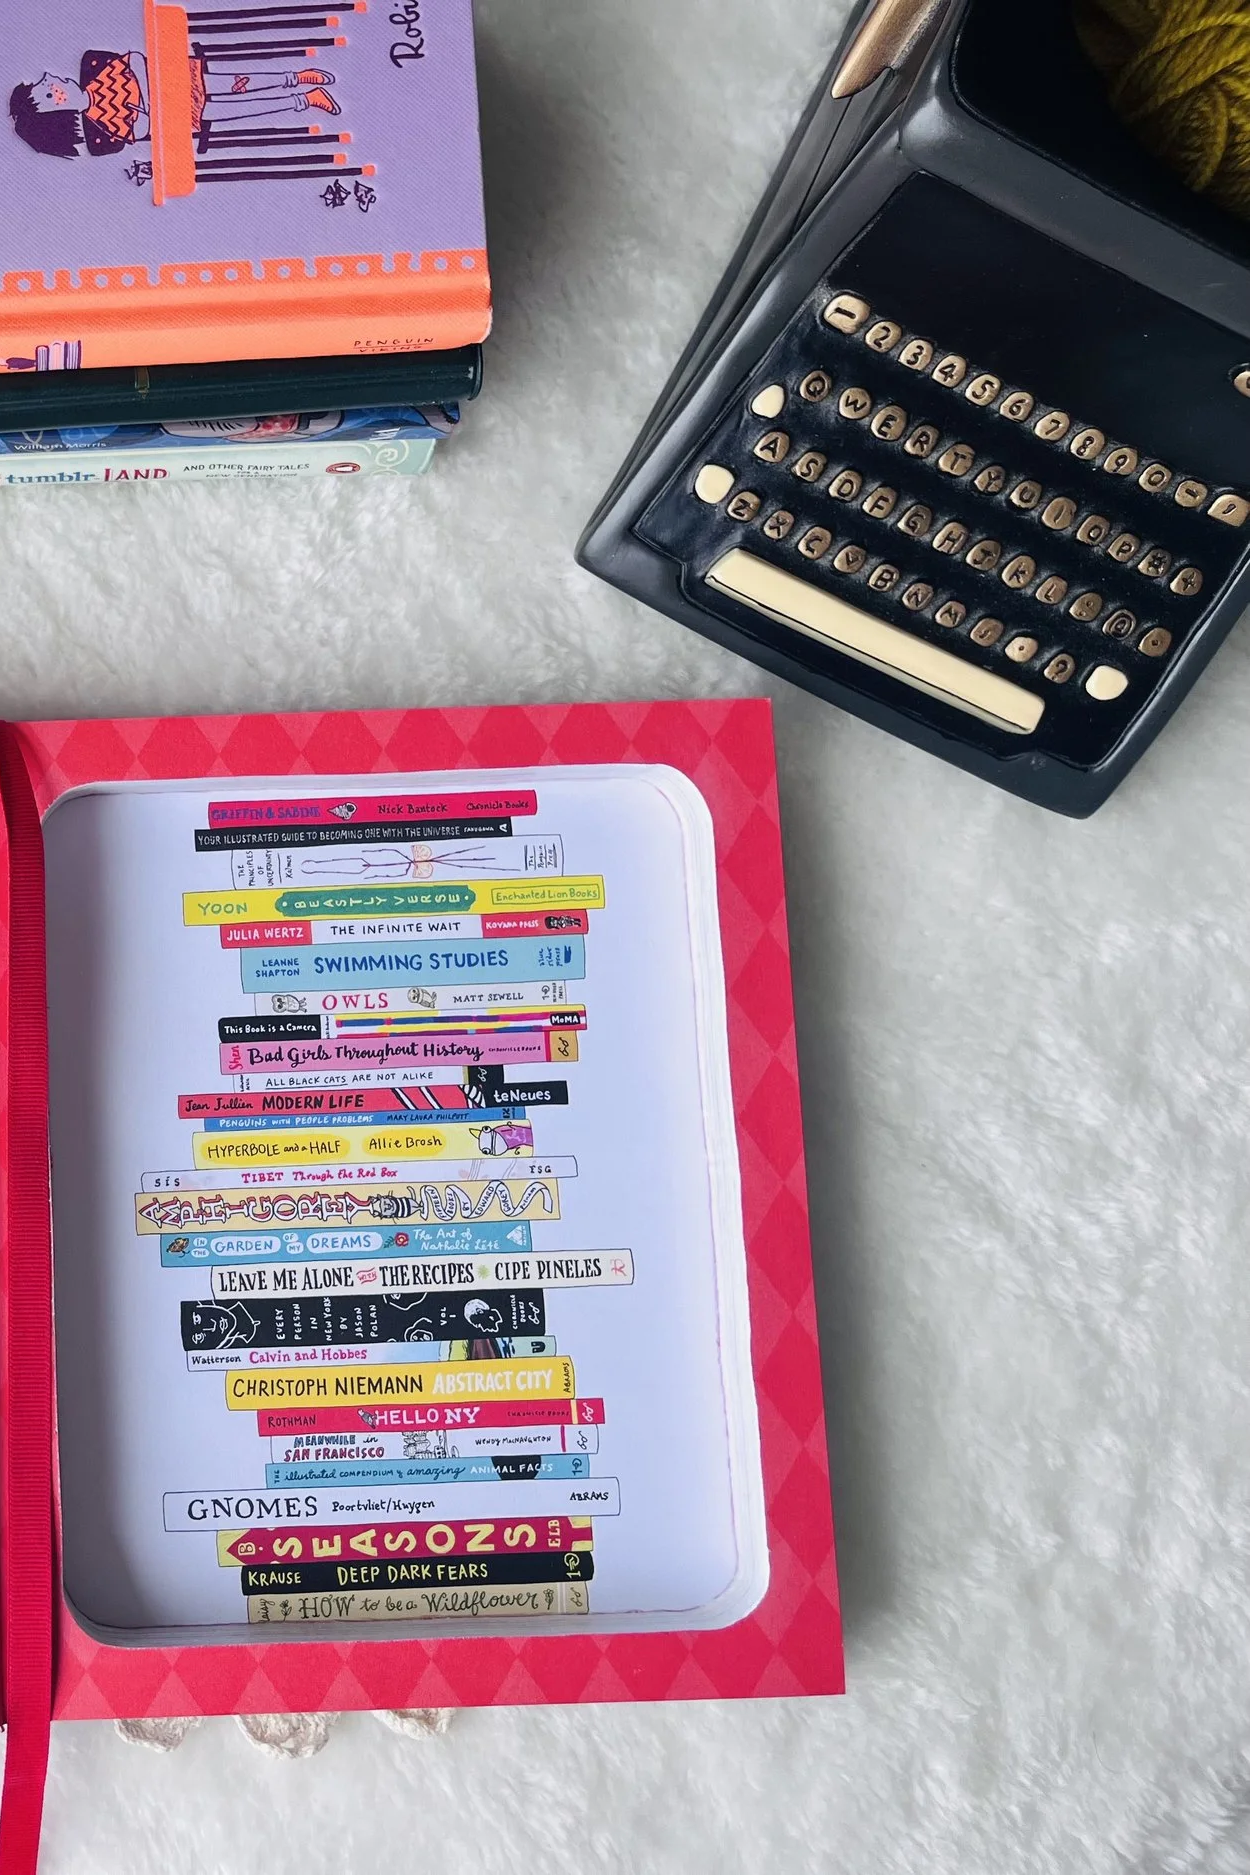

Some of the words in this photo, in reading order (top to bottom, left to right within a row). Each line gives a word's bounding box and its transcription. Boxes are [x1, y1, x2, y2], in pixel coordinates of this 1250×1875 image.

[389, 0, 425, 69] Robi
[353, 338, 434, 347] PENGUIN
[14, 441, 63, 451] William
[66, 440, 107, 449] Morris
[6, 471, 95, 484] tumblr
[104, 468, 168, 482] LAND
[183, 463, 205, 471] AND
[208, 463, 243, 471] OTHER
[247, 463, 275, 471] FAIRY
[278, 462, 310, 470] TALES
[211, 808, 264, 821] GRIFFIN
[277, 806, 321, 819] SABINE
[378, 803, 403, 815] Nick
[407, 802, 450, 815] Bantock
[197, 834, 222, 846] YOUR
[223, 832, 280, 845] ILLUSTRATED
[281, 830, 306, 842] GUIDE
[306, 831, 319, 841] TO
[319, 829, 363, 841] BECOMING
[364, 828, 384, 839] ONE
[384, 827, 404, 838] WITH
[405, 826, 422, 837] THE
[422, 825, 461, 838] UNIVERSE
[294, 896, 387, 909] BEASTLY
[393, 892, 462, 906] VERSE
[496, 888, 546, 901] Enchanted
[547, 889, 568, 899] Lion
[569, 887, 599, 899] Books
[197, 902, 248, 916] YOON
[226, 928, 261, 942] JULIA
[264, 926, 305, 940] WERTZ
[330, 925, 356, 936] THE
[362, 922, 423, 935] INFINITE
[427, 920, 462, 932] WAIT
[261, 958, 301, 968] LEANNE
[313, 954, 423, 975] SWIMMING
[429, 949, 510, 970] STUDIES
[255, 968, 301, 978] SHAPTON
[321, 991, 390, 1011] OWLS
[453, 993, 485, 1004] MATT
[487, 991, 525, 1002] SEWELL
[224, 1024, 244, 1035] This
[244, 1023, 267, 1034] Book
[286, 1021, 318, 1033] Camera
[551, 1014, 580, 1025] MoMA
[228, 1045, 244, 1070] Shen
[247, 1046, 285, 1066] Bad
[287, 1044, 332, 1068] Girls
[334, 1041, 419, 1065] Throughout
[423, 1041, 485, 1062] History
[265, 1077, 285, 1087] ALL
[288, 1075, 321, 1086] BLACK
[323, 1074, 348, 1085] CATS
[351, 1073, 372, 1083] ARE
[376, 1072, 397, 1081] NOT
[401, 1071, 435, 1081] ALIKE
[185, 1099, 211, 1113] Jean
[213, 1097, 254, 1111] Jullien
[261, 1094, 324, 1112] MODERN
[328, 1093, 365, 1109] LIFE
[493, 1087, 552, 1103] teNeues
[219, 1117, 268, 1128] PENGUINS
[294, 1115, 330, 1126] PEOPLE
[332, 1114, 374, 1125] PROBLEMS
[386, 1114, 409, 1122] MARY
[410, 1113, 434, 1122] LAURA
[435, 1112, 471, 1121] PHILPOTT
[207, 1142, 281, 1160] HYPERBOLE
[283, 1142, 300, 1153] and
[309, 1139, 342, 1155] HALF
[369, 1138, 403, 1150] Allie
[405, 1135, 443, 1149] Brosh
[241, 1171, 285, 1184] TIBET
[292, 1169, 335, 1182] Through
[356, 1168, 377, 1179] Red
[380, 1166, 399, 1178] Box
[214, 1239, 274, 1253] GARDEN
[310, 1233, 372, 1249] DREAMS
[421, 1239, 471, 1252] Nathalie
[217, 1270, 268, 1292] LEAVE
[271, 1267, 298, 1292] ME
[301, 1266, 355, 1291] ALONE
[379, 1263, 411, 1287] THE
[411, 1262, 475, 1286] RECIPES
[494, 1259, 531, 1281] CIPE
[536, 1257, 603, 1280] PINELES
[275, 1308, 286, 1341] EVERY
[292, 1302, 303, 1341] PERSON
[353, 1306, 364, 1338] JASON
[368, 1303, 379, 1338] POLAN
[191, 1354, 242, 1366] Watterson
[250, 1349, 291, 1364] Calvin
[294, 1348, 319, 1361] and
[321, 1347, 368, 1361] Hobbes
[232, 1376, 328, 1398] CHRISTOPH
[335, 1374, 423, 1397] NIEMANN
[432, 1370, 513, 1395] ABSTRACT
[515, 1368, 554, 1391] CITY
[268, 1414, 317, 1429] ROTHMAN
[374, 1408, 440, 1426] HELLO
[443, 1406, 481, 1425] NY
[293, 1434, 357, 1448] MEANWHILE
[474, 1437, 501, 1447] WENDY
[283, 1447, 311, 1463] SAN
[314, 1446, 386, 1461] FRANCISCO
[283, 1466, 337, 1482] illustrated
[339, 1468, 394, 1478] COMPENDIUM
[406, 1465, 467, 1481] amazing
[470, 1464, 517, 1475] ANIMAL
[518, 1462, 554, 1473] FACTS
[187, 1494, 319, 1520] GNOMES
[569, 1490, 610, 1502] ABRAMS
[271, 1522, 537, 1559] SEASONS
[248, 1570, 302, 1587] KRAUSE
[336, 1565, 381, 1587] DEEP
[387, 1563, 431, 1584] DARK
[436, 1562, 489, 1581] FEARS
[299, 1594, 356, 1620] HOW
[360, 1597, 382, 1612] to
[421, 1589, 539, 1617] Wildflower
